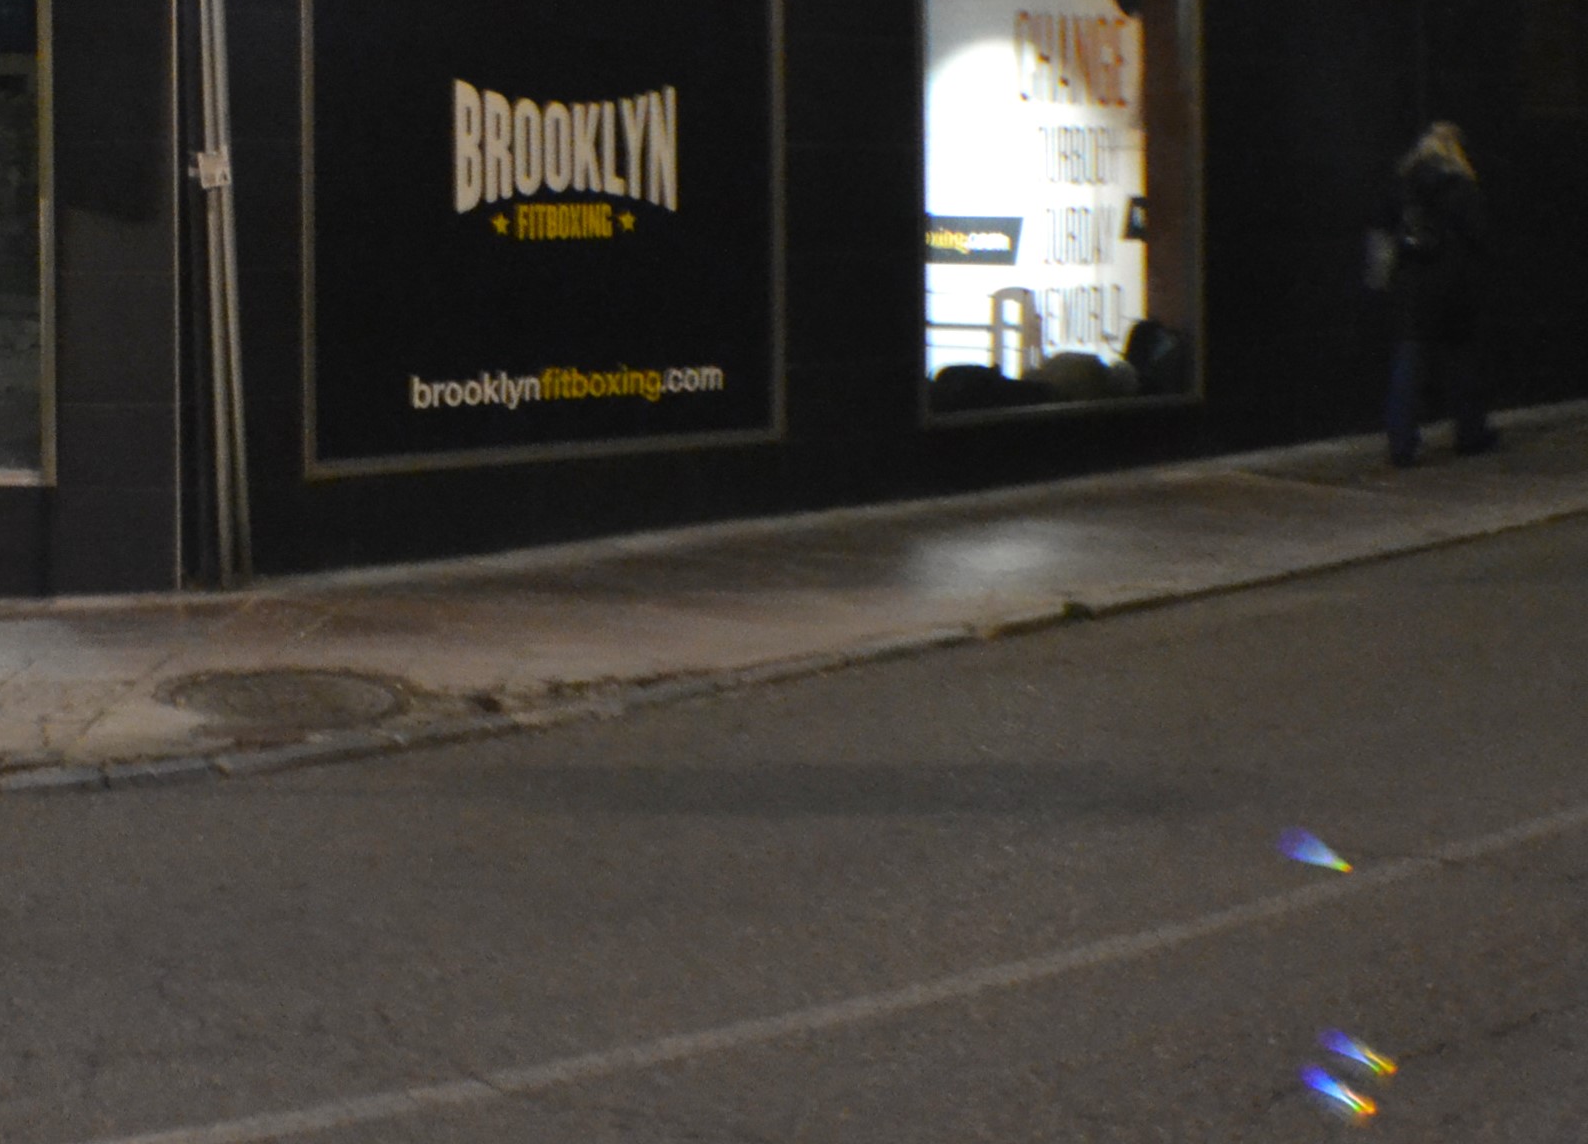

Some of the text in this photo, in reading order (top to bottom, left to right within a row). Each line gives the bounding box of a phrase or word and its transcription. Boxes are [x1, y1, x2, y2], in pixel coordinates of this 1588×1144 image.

[454, 77, 679, 214] BROOKLYN
[516, 202, 614, 240] FITBOXING
[410, 364, 724, 410] brooklynfitboxing.com
